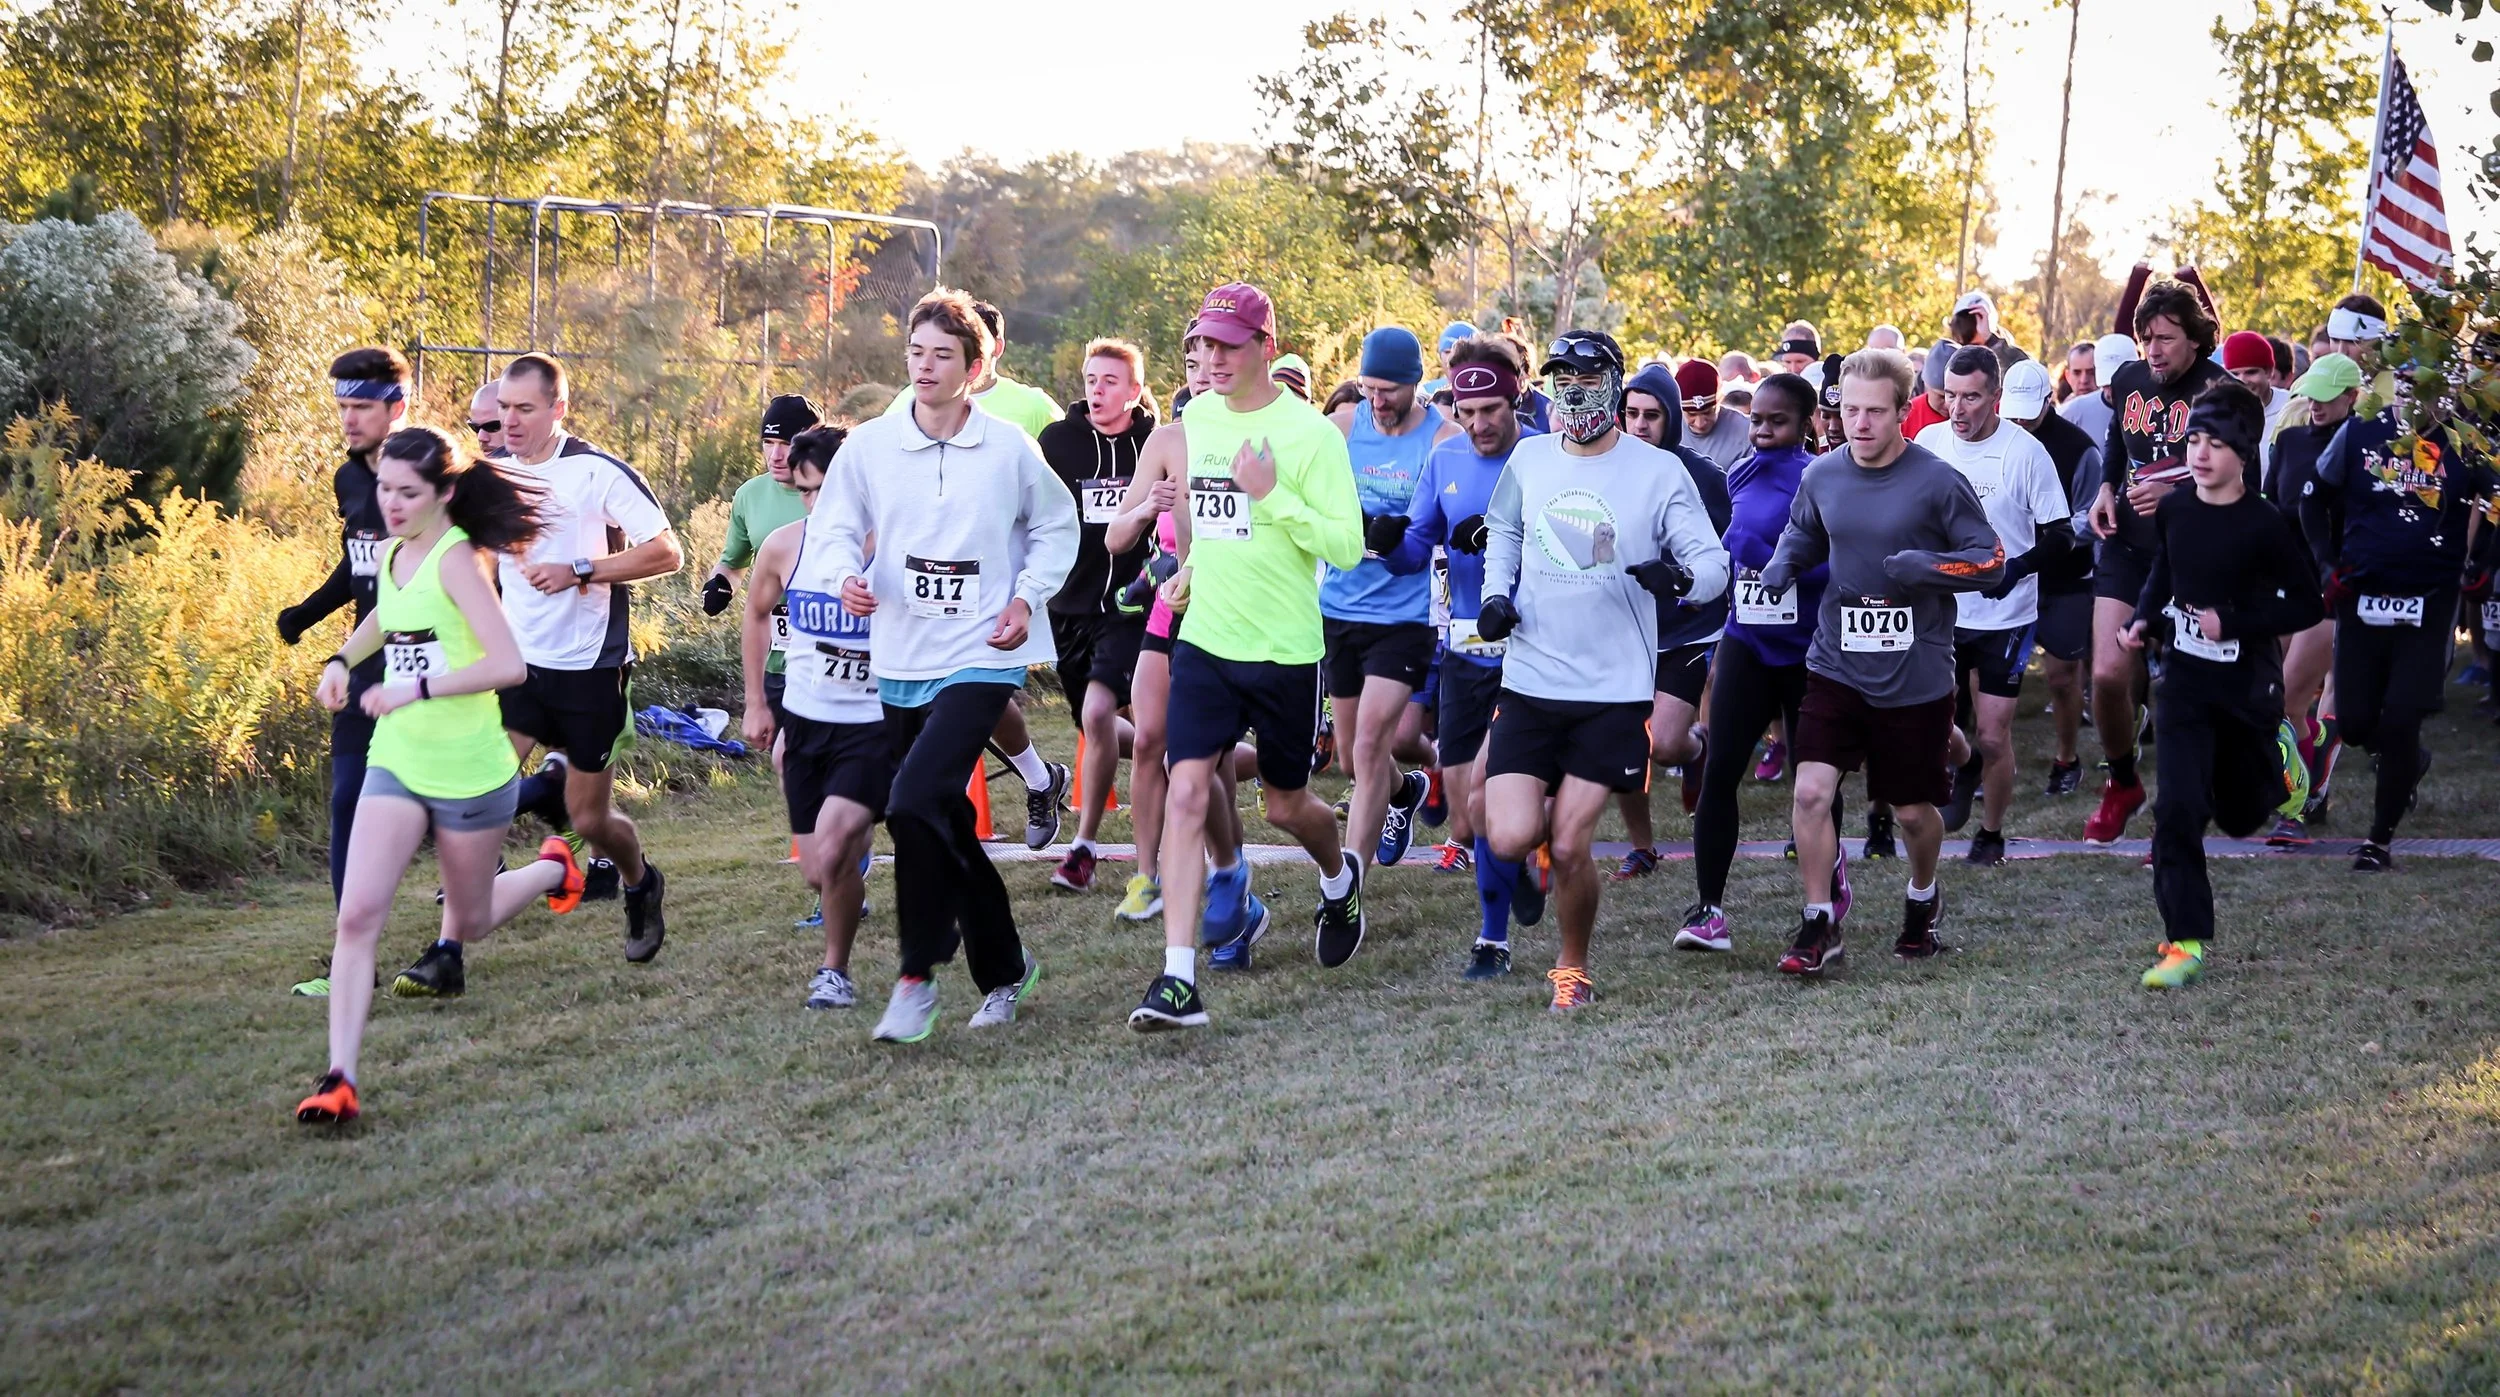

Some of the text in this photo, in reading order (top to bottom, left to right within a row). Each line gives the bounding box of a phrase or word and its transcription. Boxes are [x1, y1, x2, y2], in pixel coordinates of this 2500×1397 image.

[1203, 454, 1231, 466] RUN
[1195, 493, 1237, 519] 730
[915, 575, 965, 601] 817
[1847, 610, 1909, 634] 1070
[823, 657, 871, 682] 715
